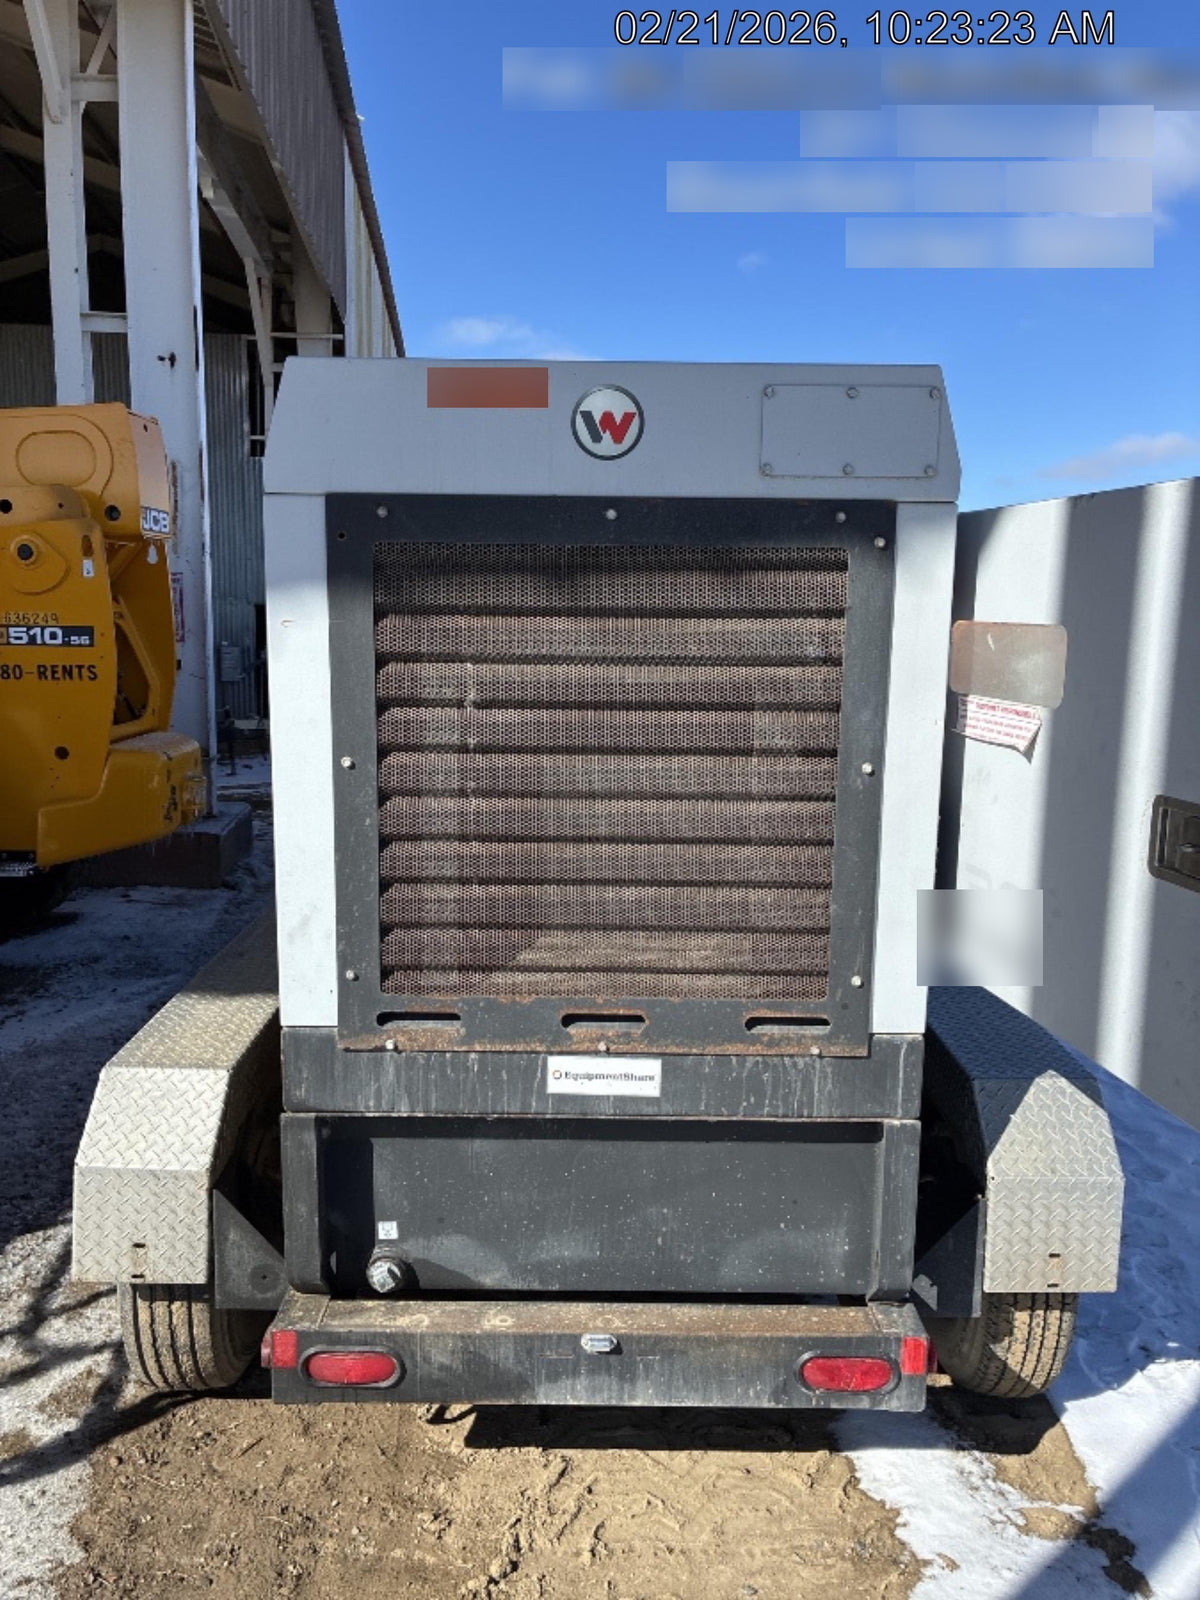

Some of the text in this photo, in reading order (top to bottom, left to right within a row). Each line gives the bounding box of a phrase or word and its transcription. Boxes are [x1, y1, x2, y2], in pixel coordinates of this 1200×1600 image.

[143, 508, 170, 533] JCB
[0, 664, 98, 681] 80-RENTS
[564, 1071, 656, 1082] EquipmentShare
